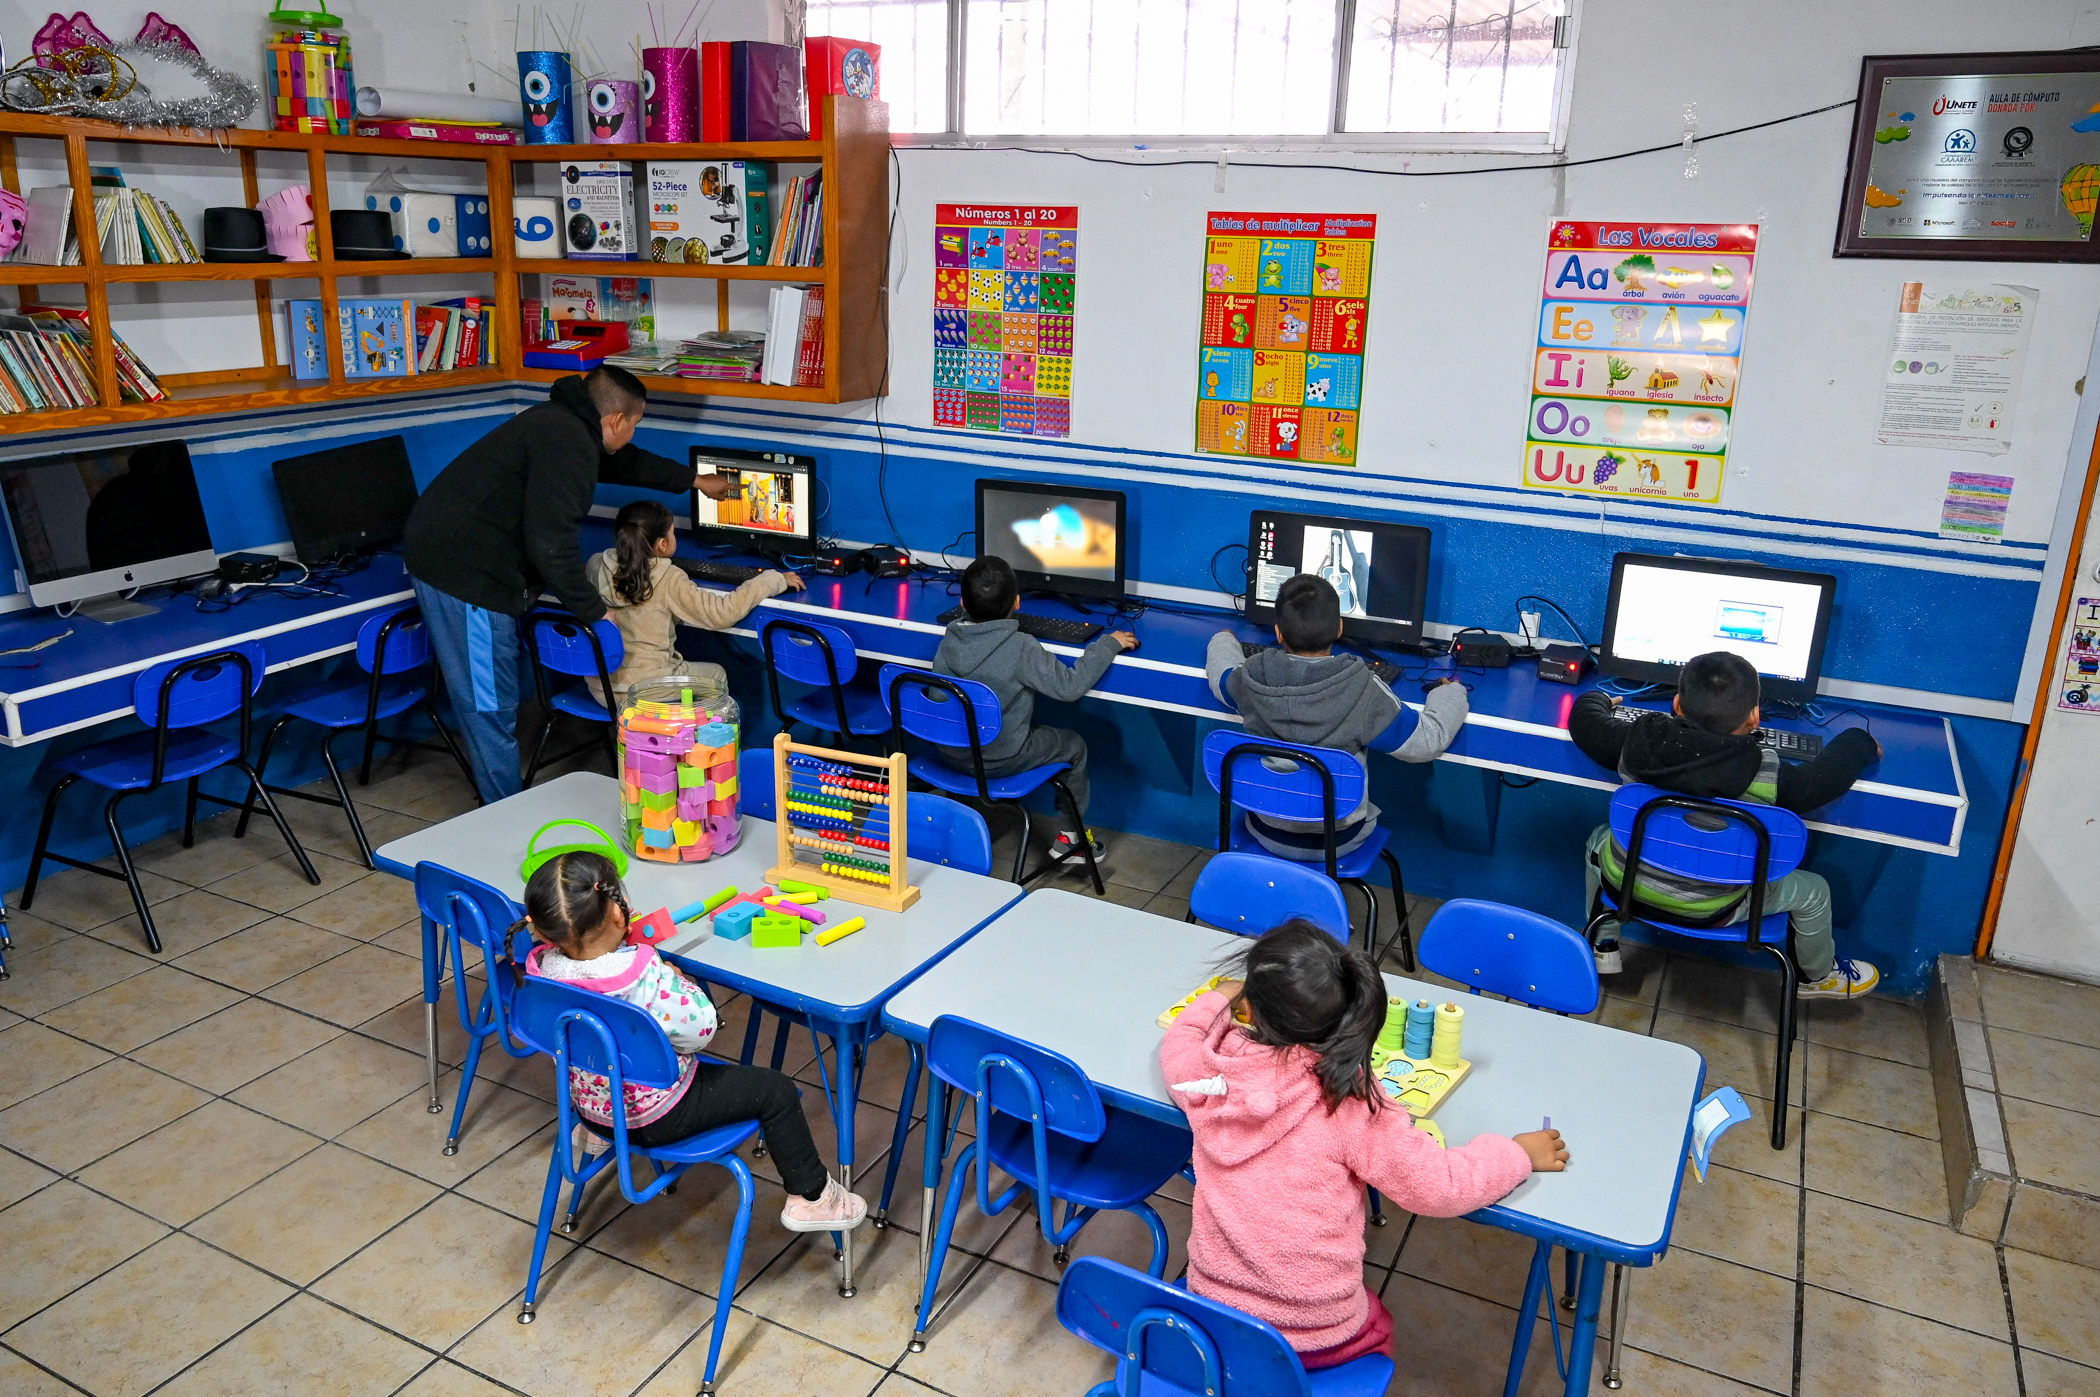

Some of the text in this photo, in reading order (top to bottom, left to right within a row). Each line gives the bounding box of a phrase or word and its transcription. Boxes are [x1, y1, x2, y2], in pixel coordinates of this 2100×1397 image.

[1989, 93, 2008, 103] AULA
[2011, 93, 2020, 102] DE
[1988, 104, 2018, 113] DONADA
[566, 185, 618, 195] ELECTRICITY
[652, 182, 687, 191] 52-Piece
[956, 207, 1057, 220] Números 1 al 20
[1211, 218, 1320, 234] Tablas de multiplicar
[1325, 219, 1373, 228] Multiplication
[1598, 227, 1718, 249] Las Vocales
[1210, 240, 1215, 254] 1
[1262, 240, 1273, 256] 2
[1316, 242, 1345, 257] 3 tres
[1555, 254, 1609, 291] Aa
[1224, 295, 1235, 310] 4
[1622, 289, 1740, 302] árbol avión aguacate
[588, 301, 593, 310] 3
[1278, 298, 1288, 312] 5
[1335, 299, 1347, 315] 6
[2013, 302, 2021, 311] 5
[1551, 306, 1594, 341] Ee
[338, 307, 356, 374] SCIENCE
[462, 329, 471, 358] Dictionary
[1203, 348, 1213, 362] 7
[1254, 351, 1265, 366] 8
[1308, 354, 1319, 369] 9
[1544, 353, 1586, 388] Ii
[1606, 388, 1724, 402] iguana iglesia insecto
[1222, 404, 1236, 416] 10
[1272, 407, 1282, 419] 11
[1327, 411, 1341, 422] 12
[1536, 401, 1590, 437] Oo
[1602, 436, 1622, 445] oreja
[1692, 443, 1705, 451] ojo
[1534, 449, 1585, 484] Uu
[1684, 459, 1699, 490] 1
[1629, 487, 1667, 496] unicornio
[1683, 491, 1699, 499] uno
